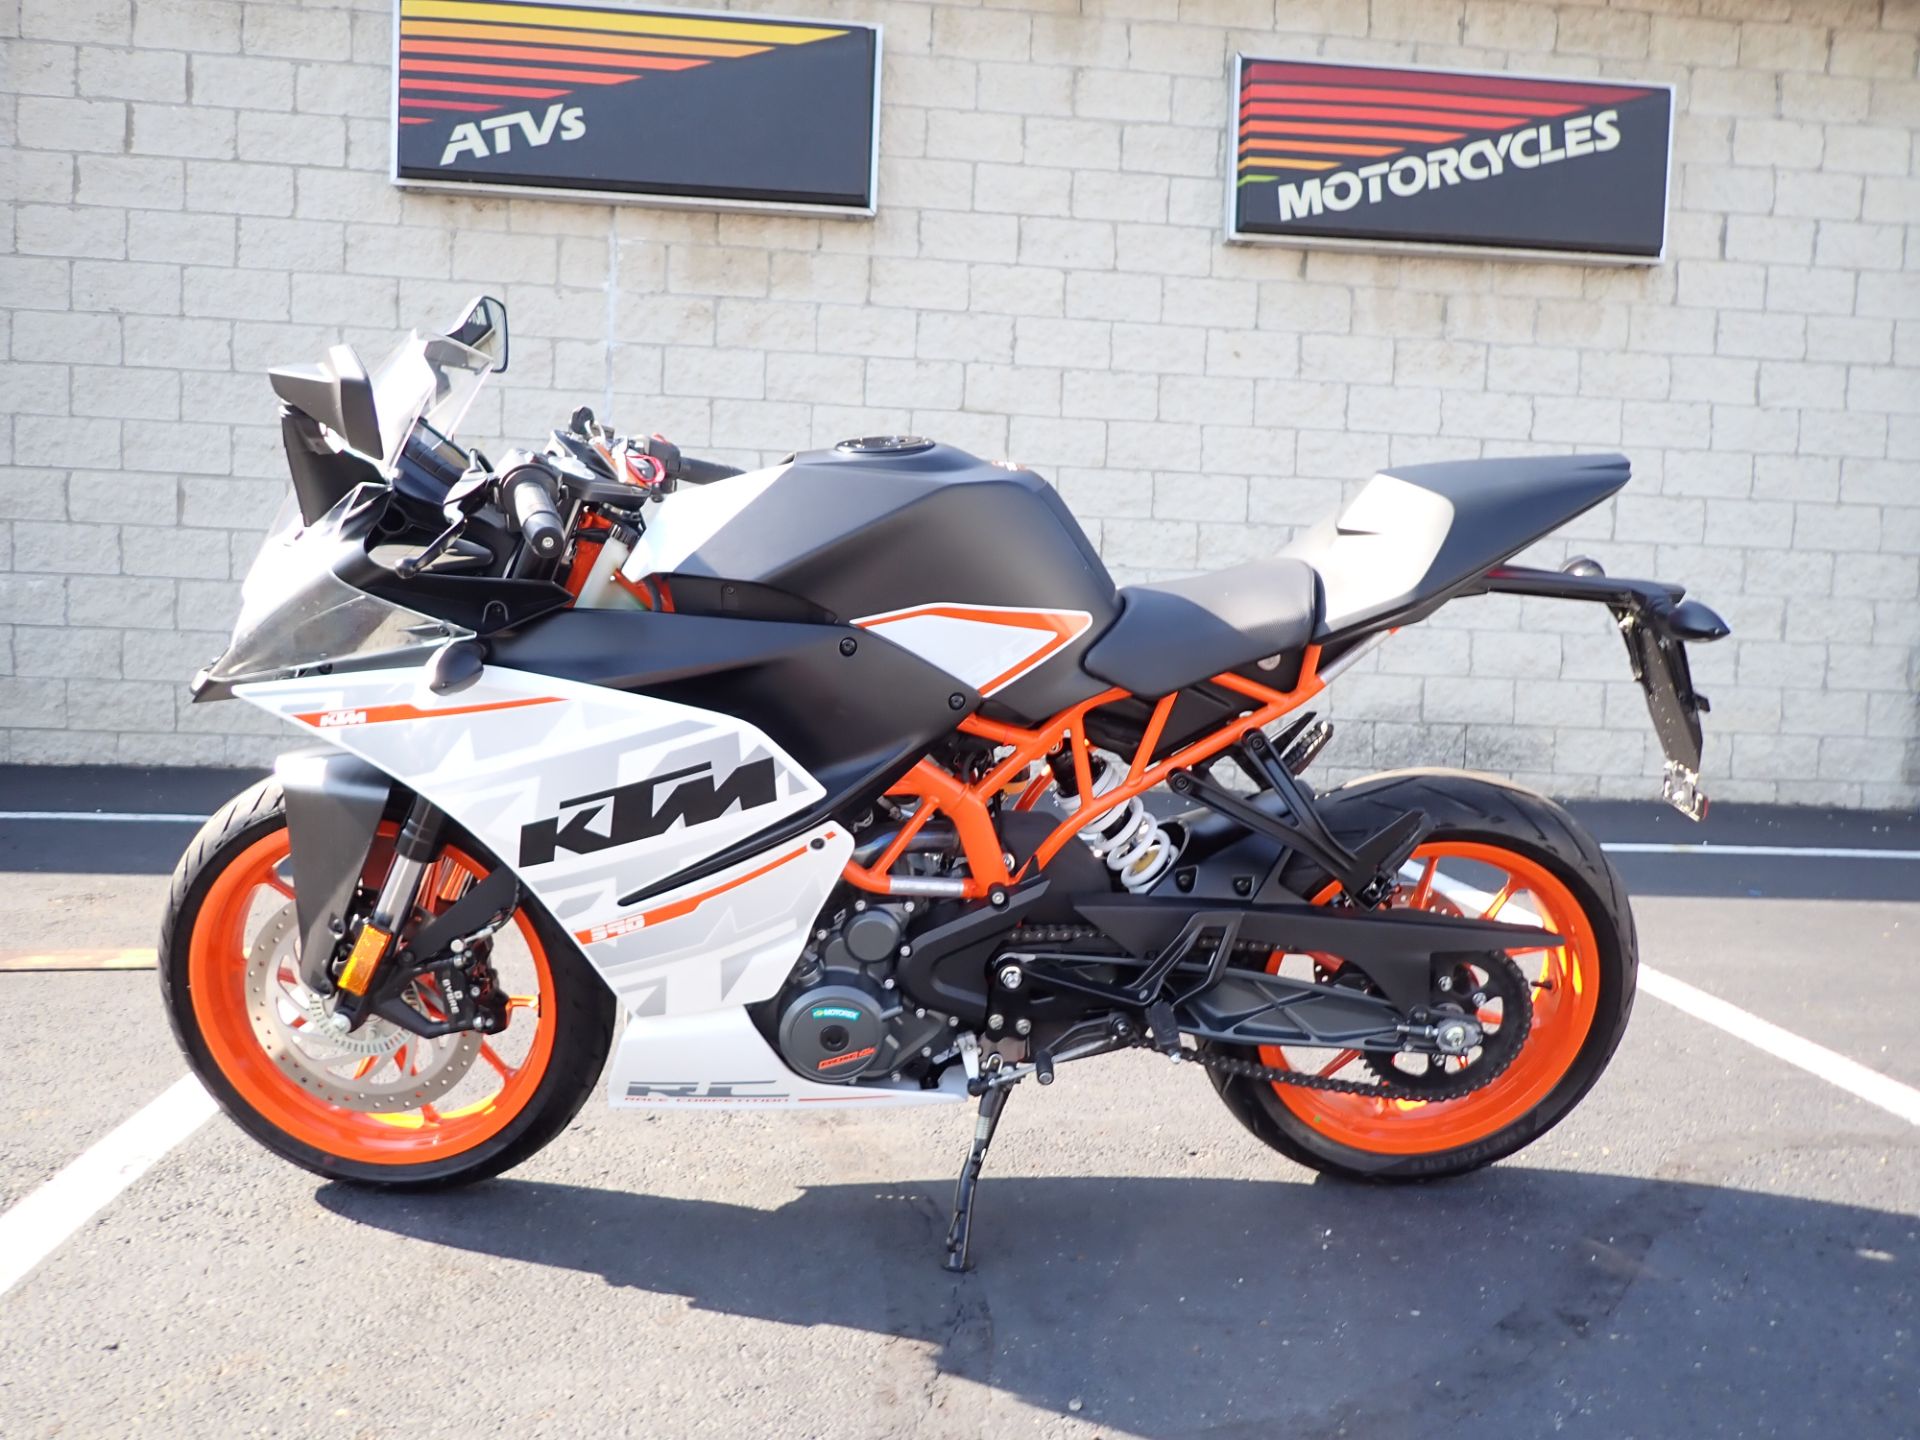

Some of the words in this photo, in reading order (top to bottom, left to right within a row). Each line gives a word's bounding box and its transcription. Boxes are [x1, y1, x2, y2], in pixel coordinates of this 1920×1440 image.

[439, 102, 587, 166] ATVs
[1278, 110, 1621, 221] MOTORCYCLES
[320, 711, 367, 727] KTM
[519, 757, 777, 868] KTM
[590, 914, 645, 942] 390
[442, 978, 459, 1013] BYBRE
[626, 1079, 790, 1097] RC
